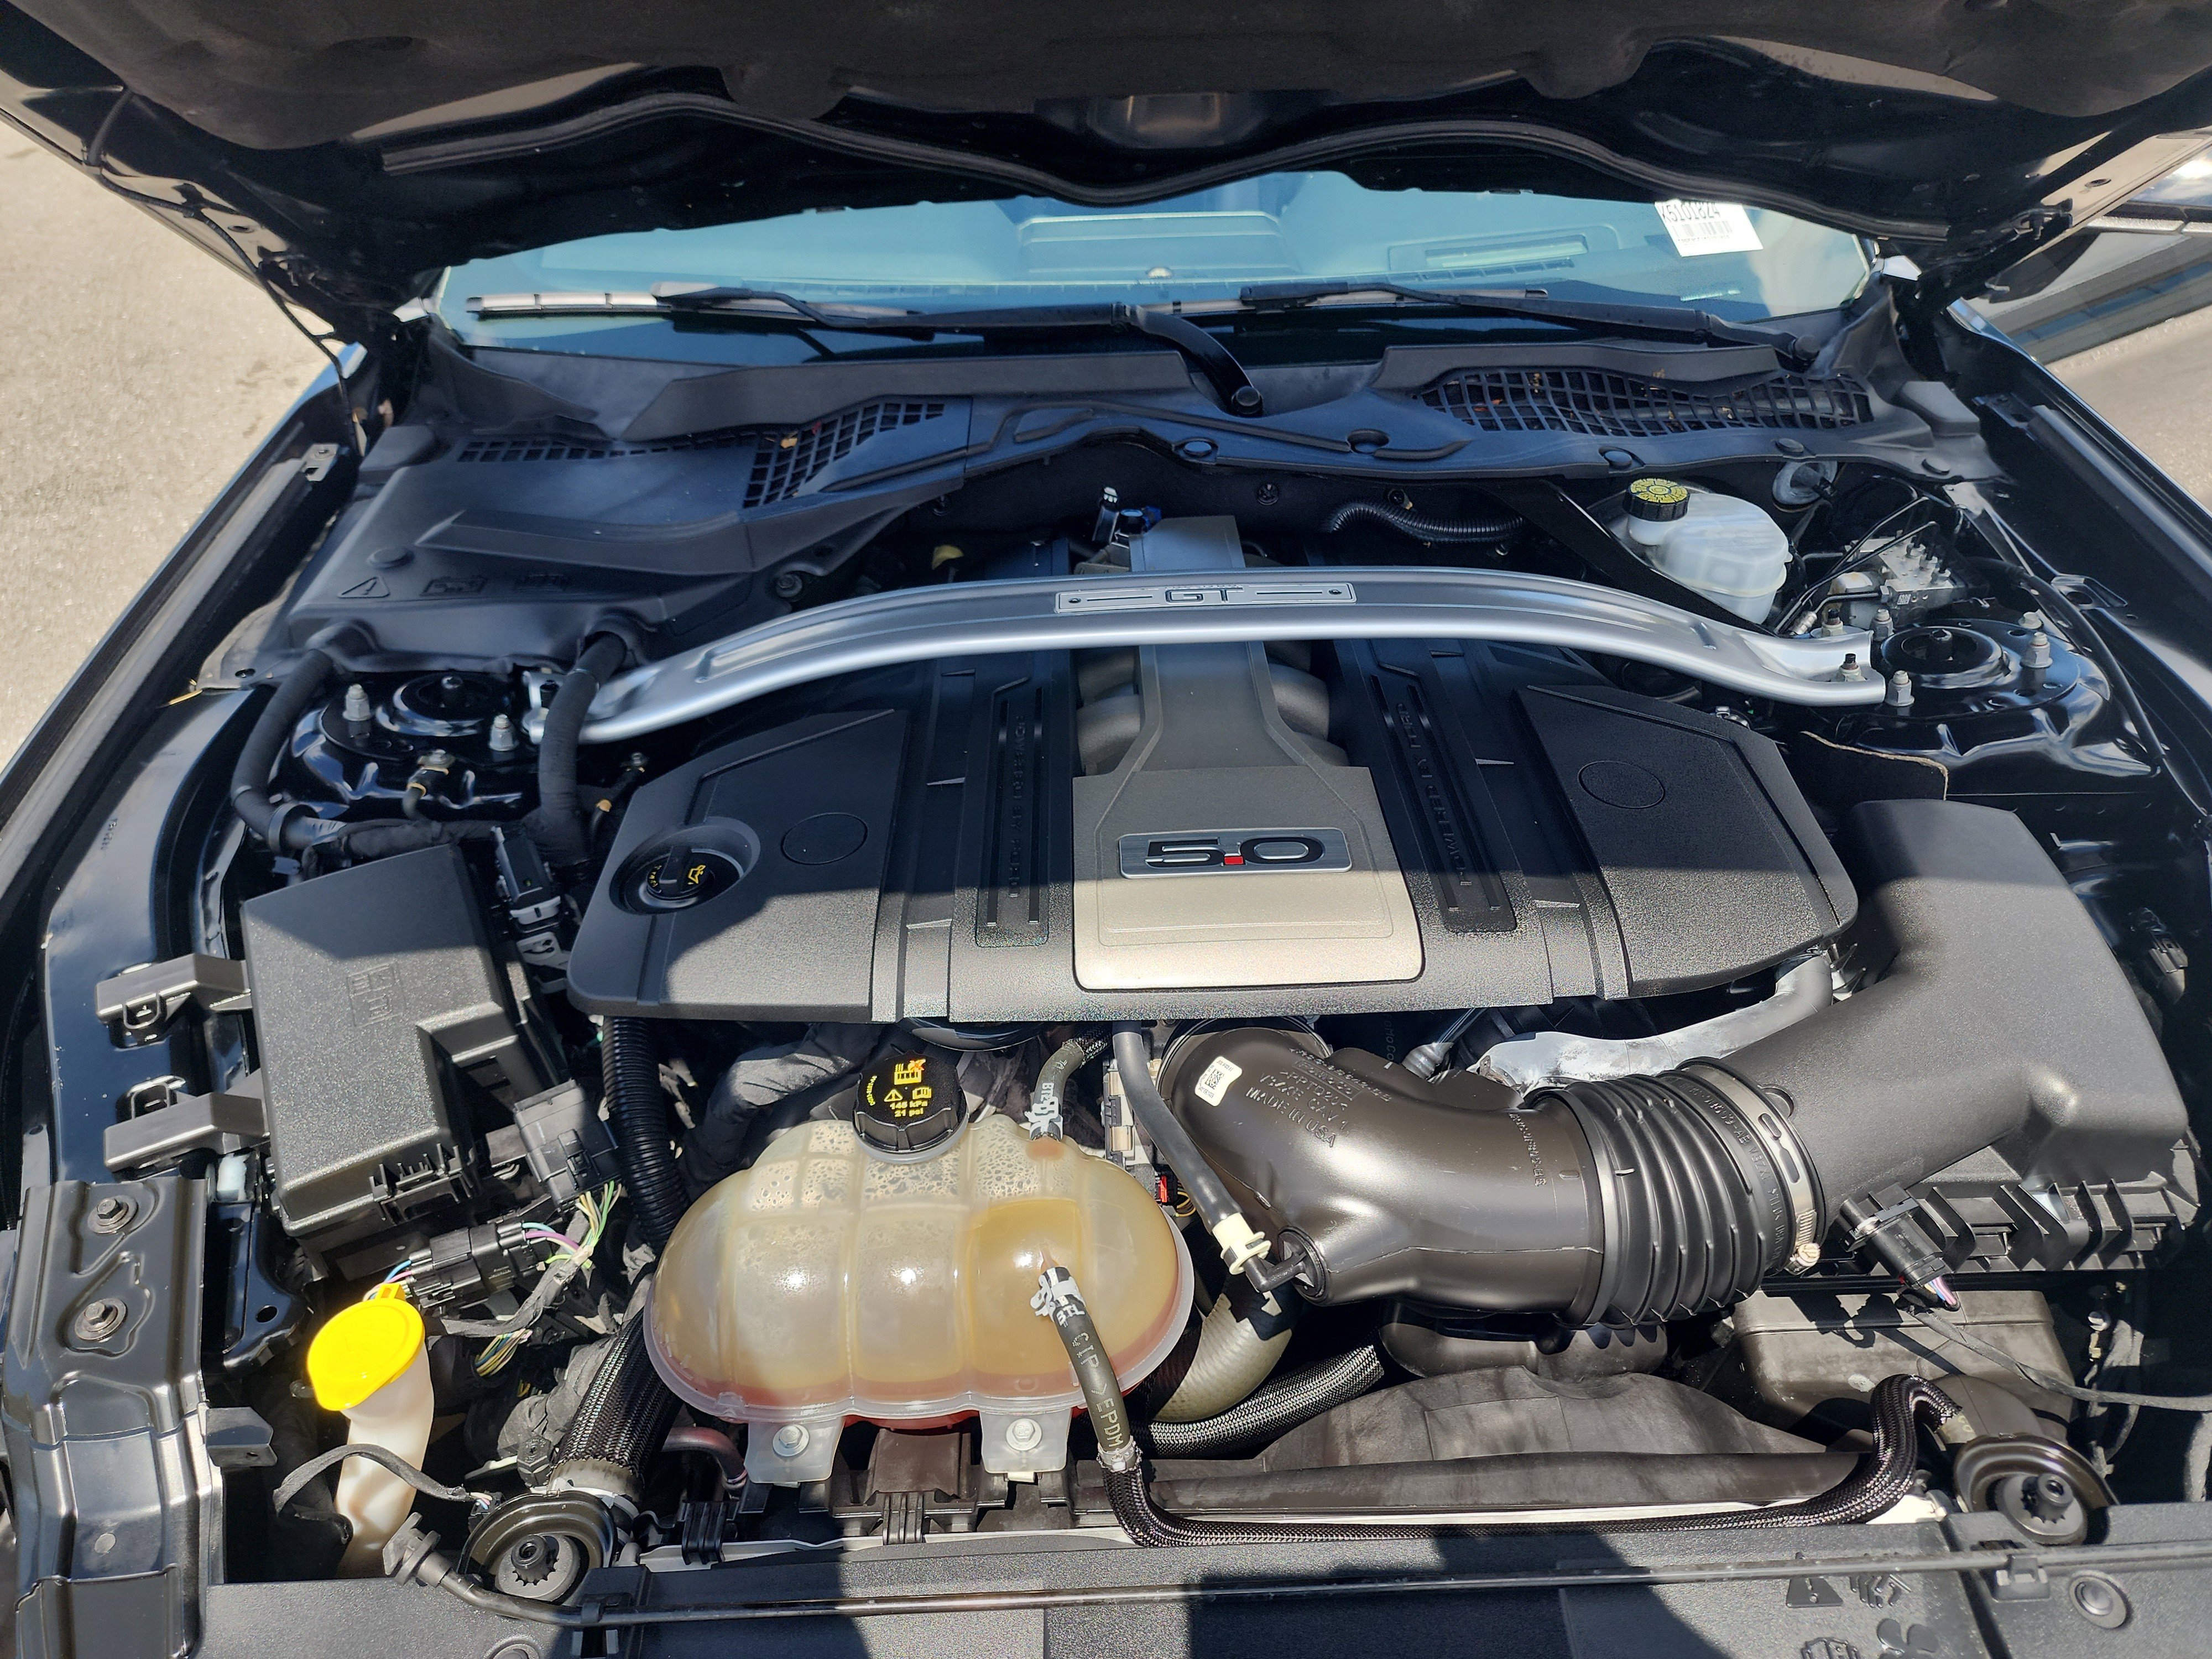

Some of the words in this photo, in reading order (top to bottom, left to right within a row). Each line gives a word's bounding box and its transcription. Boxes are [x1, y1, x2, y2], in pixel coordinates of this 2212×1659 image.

[1165, 587, 1244, 604] GT
[1145, 836, 1326, 869] 5.0
[890, 1100, 907, 1110] 145
[909, 1100, 928, 1108] kPa
[909, 1108, 924, 1117] psi
[1246, 1087, 1290, 1114] MADE
[1288, 1108, 1306, 1124] IN
[1306, 1117, 1336, 1148] USA
